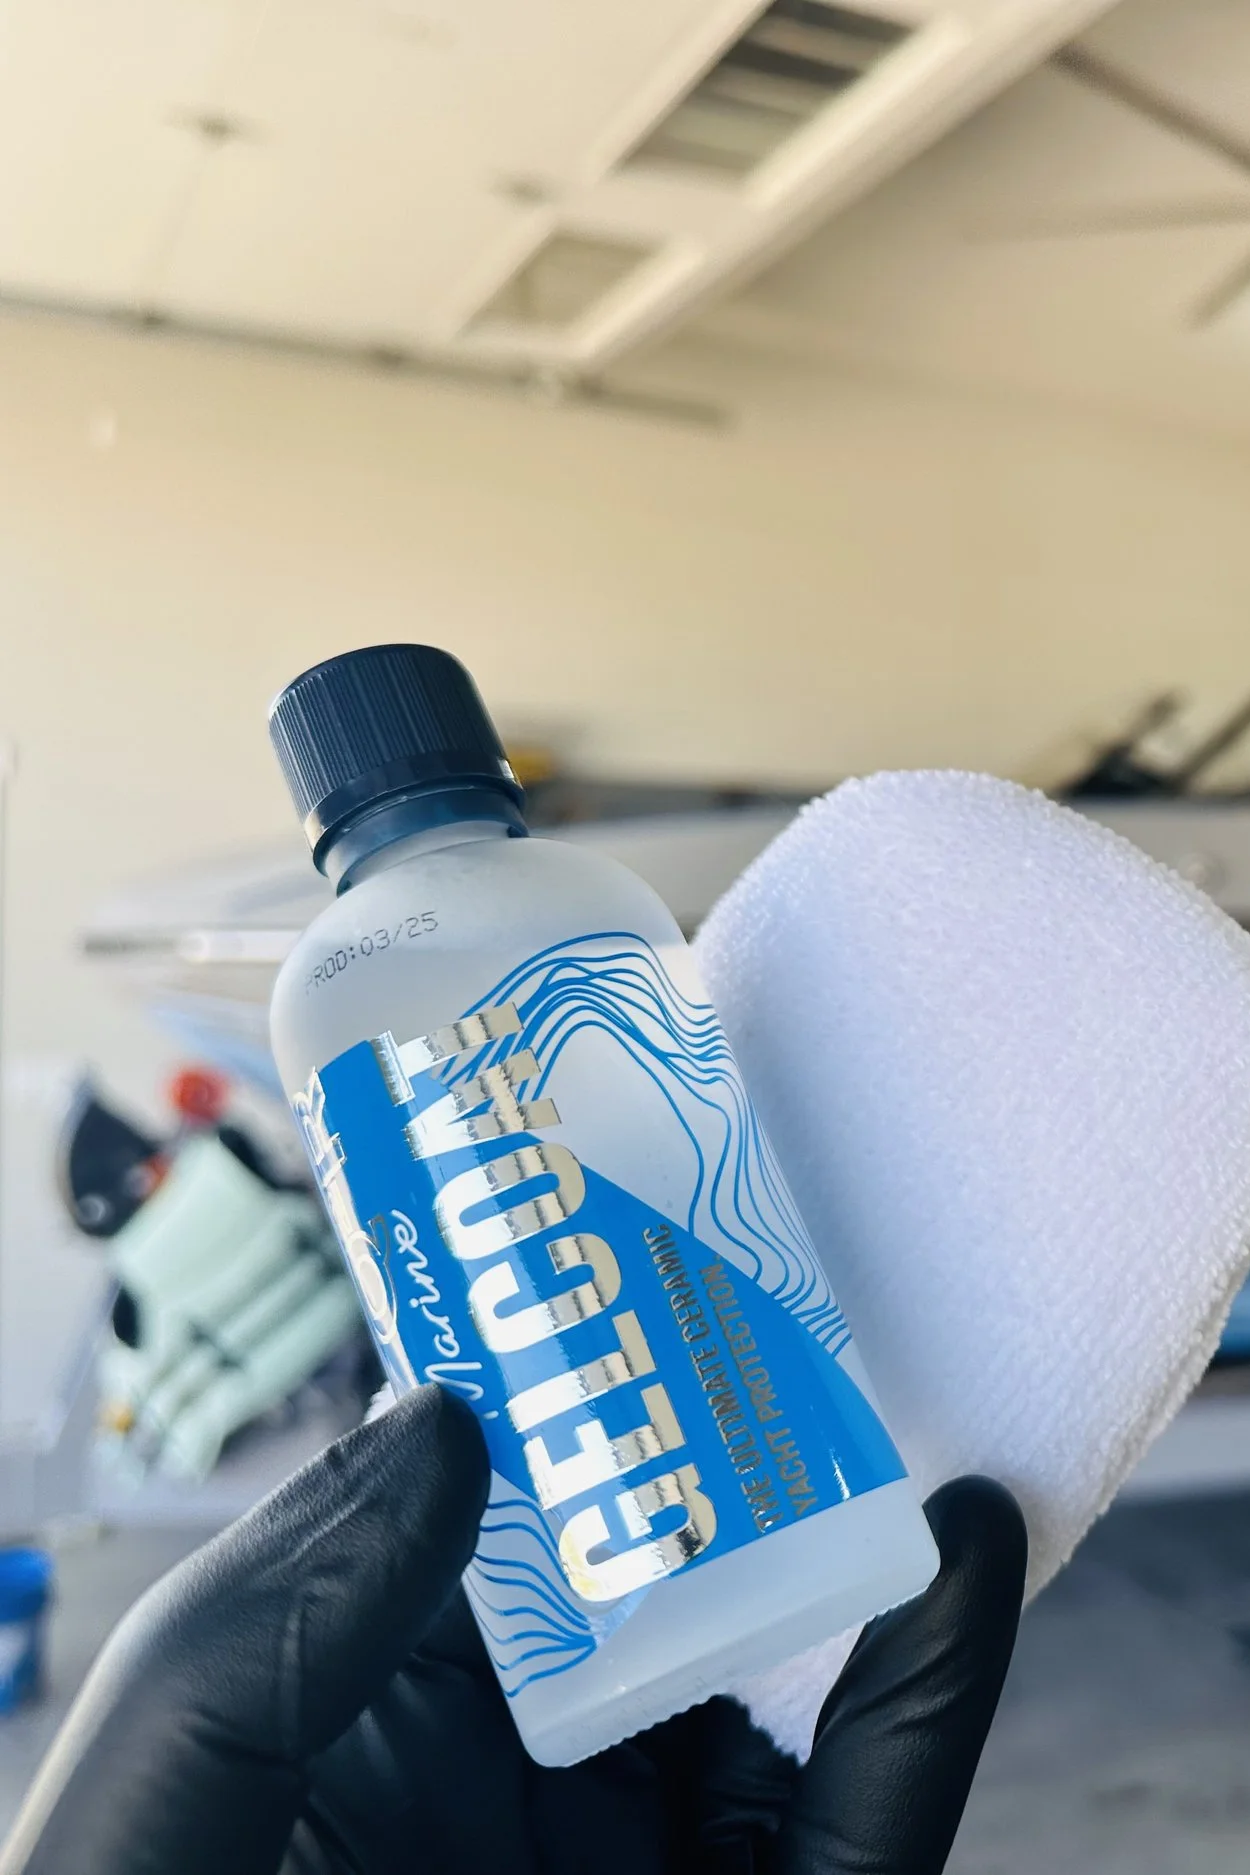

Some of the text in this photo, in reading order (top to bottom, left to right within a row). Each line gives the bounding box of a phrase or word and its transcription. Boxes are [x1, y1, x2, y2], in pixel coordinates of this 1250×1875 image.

[371, 1000, 718, 1603] GELCOAT
[391, 1209, 500, 1420] Marine
[642, 1223, 783, 1534] THE ULTIMATE CERAMIC
[698, 1254, 819, 1518] YACHT PROTECTION.
